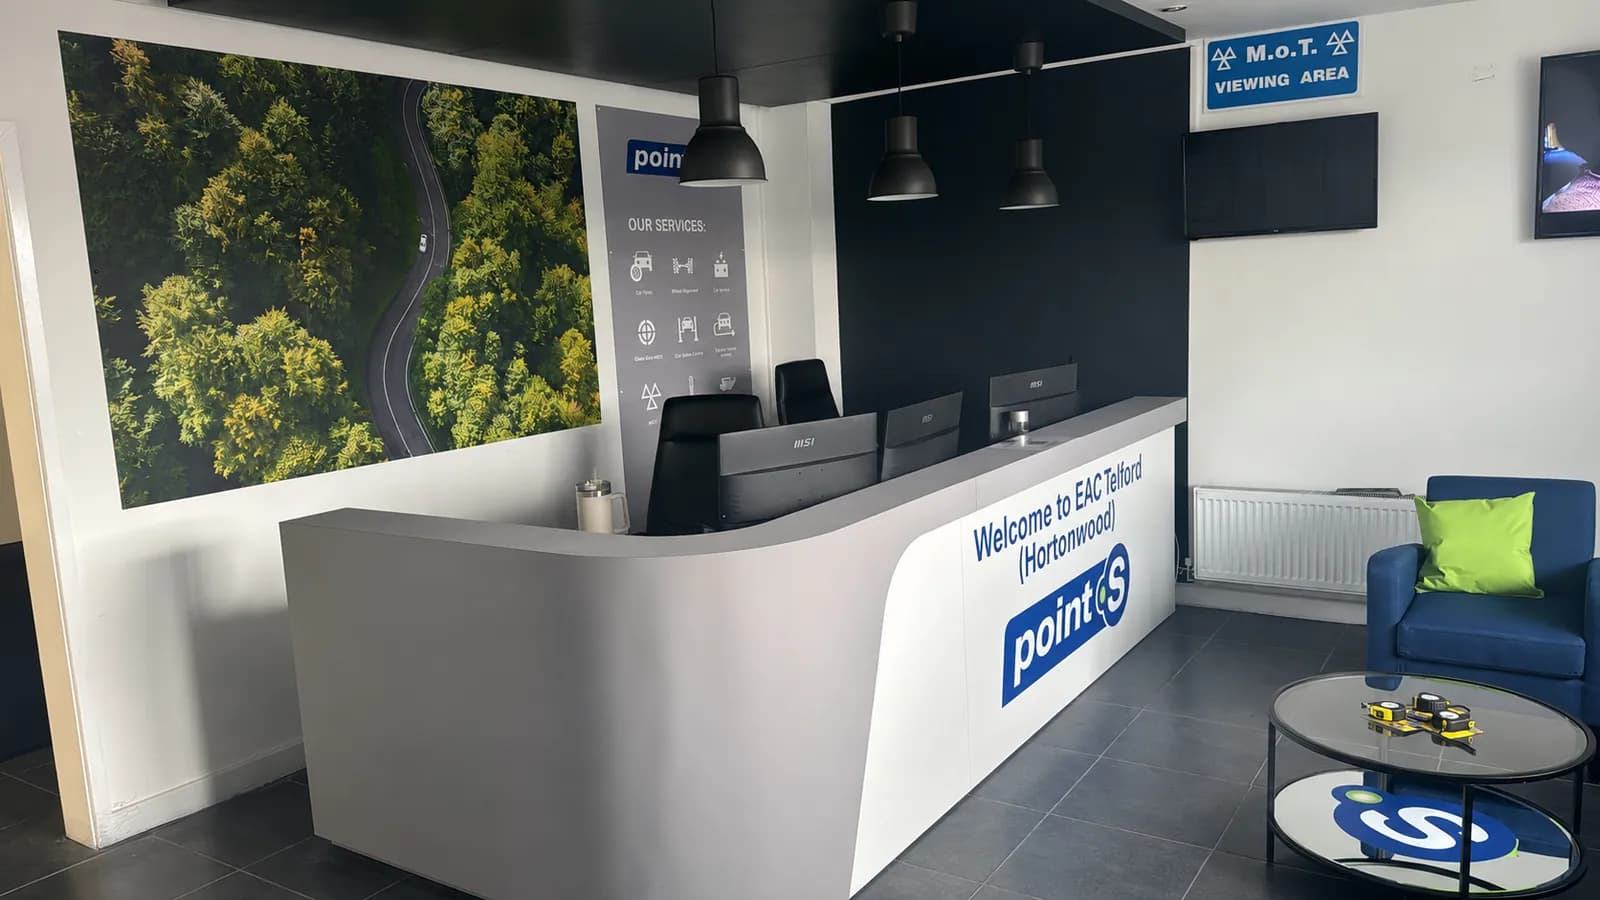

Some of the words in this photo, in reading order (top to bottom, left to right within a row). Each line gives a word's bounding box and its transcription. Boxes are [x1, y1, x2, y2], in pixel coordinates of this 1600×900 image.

[1246, 38, 1318, 63] M.o.T.
[1215, 73, 1290, 94] VIEWING
[1300, 66, 1350, 84] AREA
[634, 147, 685, 170] poin
[628, 217, 652, 232] OUR
[655, 218, 706, 233] SERVICES:
[973, 504, 1051, 562] Welcome
[1056, 493, 1071, 521] to
[1075, 473, 1102, 511] EAC
[1103, 453, 1142, 495] Telford
[1019, 499, 1116, 585] (Hortonwood)
[1013, 580, 1093, 689] point
[1107, 556, 1126, 613] S
